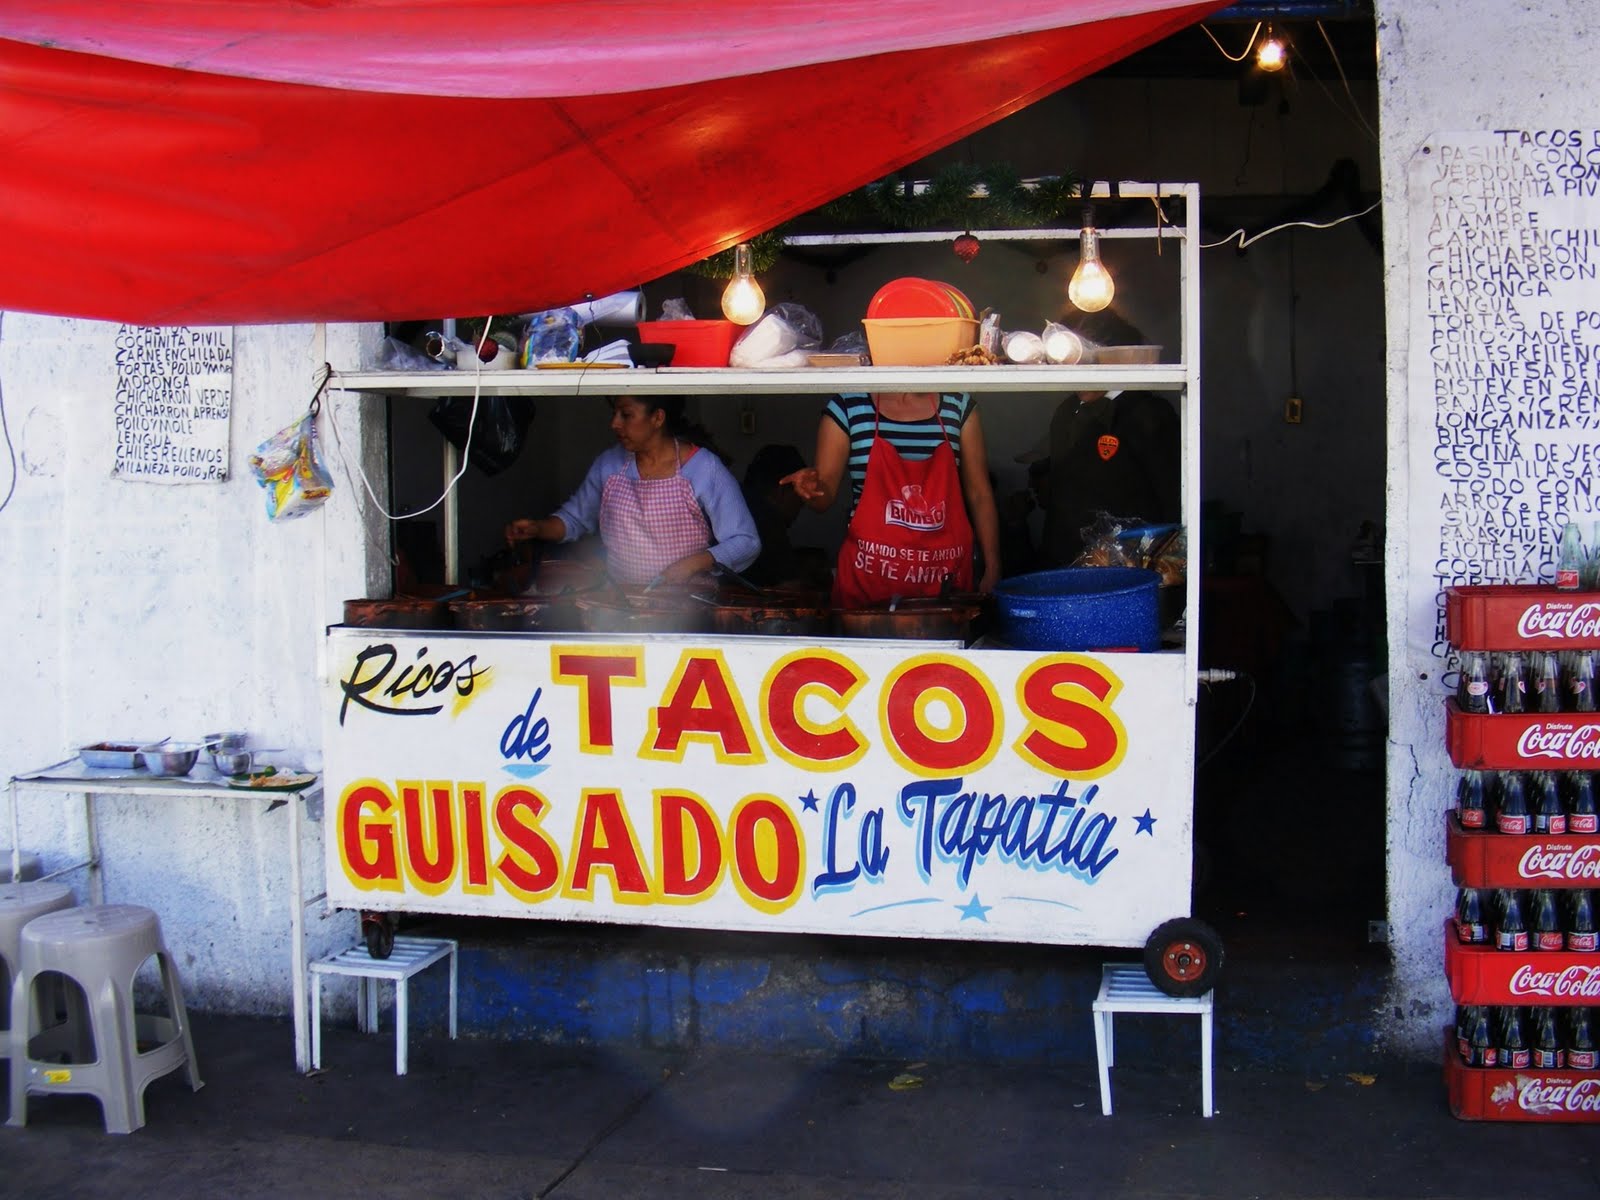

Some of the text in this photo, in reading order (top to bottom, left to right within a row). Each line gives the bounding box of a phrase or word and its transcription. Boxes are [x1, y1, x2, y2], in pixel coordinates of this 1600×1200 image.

[1494, 129, 1582, 148] TACOS
[1531, 148, 1581, 164] CON
[1430, 179, 1556, 197] COCHINITA
[1433, 196, 1522, 214] PASTOR
[1428, 229, 1511, 247] CARNE
[1428, 246, 1588, 264] CHICHARRON
[1428, 263, 1596, 280] CHICHARRON
[1427, 279, 1552, 297] MORONGA
[1428, 296, 1518, 313] LENGUA
[1428, 313, 1525, 331] TORTAS
[1541, 311, 1565, 330] DE
[115, 332, 226, 350] COCHINITA PIVIL
[115, 348, 161, 362] CARNE
[1430, 344, 1511, 362] CHILES
[115, 362, 164, 376] TORTAS
[1434, 361, 1556, 380] MILANESA
[1564, 361, 1588, 379] DE
[117, 375, 190, 390] MORONGA
[1434, 378, 1515, 396] BISTEK
[1524, 379, 1552, 396] EN
[115, 388, 230, 407] CHICHARRON VERDE
[1435, 394, 1512, 412] RAJAS
[114, 403, 189, 419] CHICHARRON
[1435, 411, 1570, 429] LONGANIZA
[118, 431, 171, 447] LENGUA
[1437, 428, 1520, 445] BISTEK
[116, 445, 222, 463] CHILES RELLENOS
[1434, 444, 1523, 461] CECINA
[1535, 443, 1559, 462] DE
[1450, 477, 1591, 496] TODO CON
[1440, 493, 1513, 511] ARROZ
[900, 548, 915, 561] SE
[917, 550, 930, 561] TE
[1440, 541, 1516, 560] EJOTES
[855, 552, 875, 574] SE
[880, 559, 900, 580] TE
[339, 643, 1128, 781] Ricos TACOS
[499, 687, 551, 763] de
[337, 777, 807, 915] GUISADO
[811, 782, 889, 900] La
